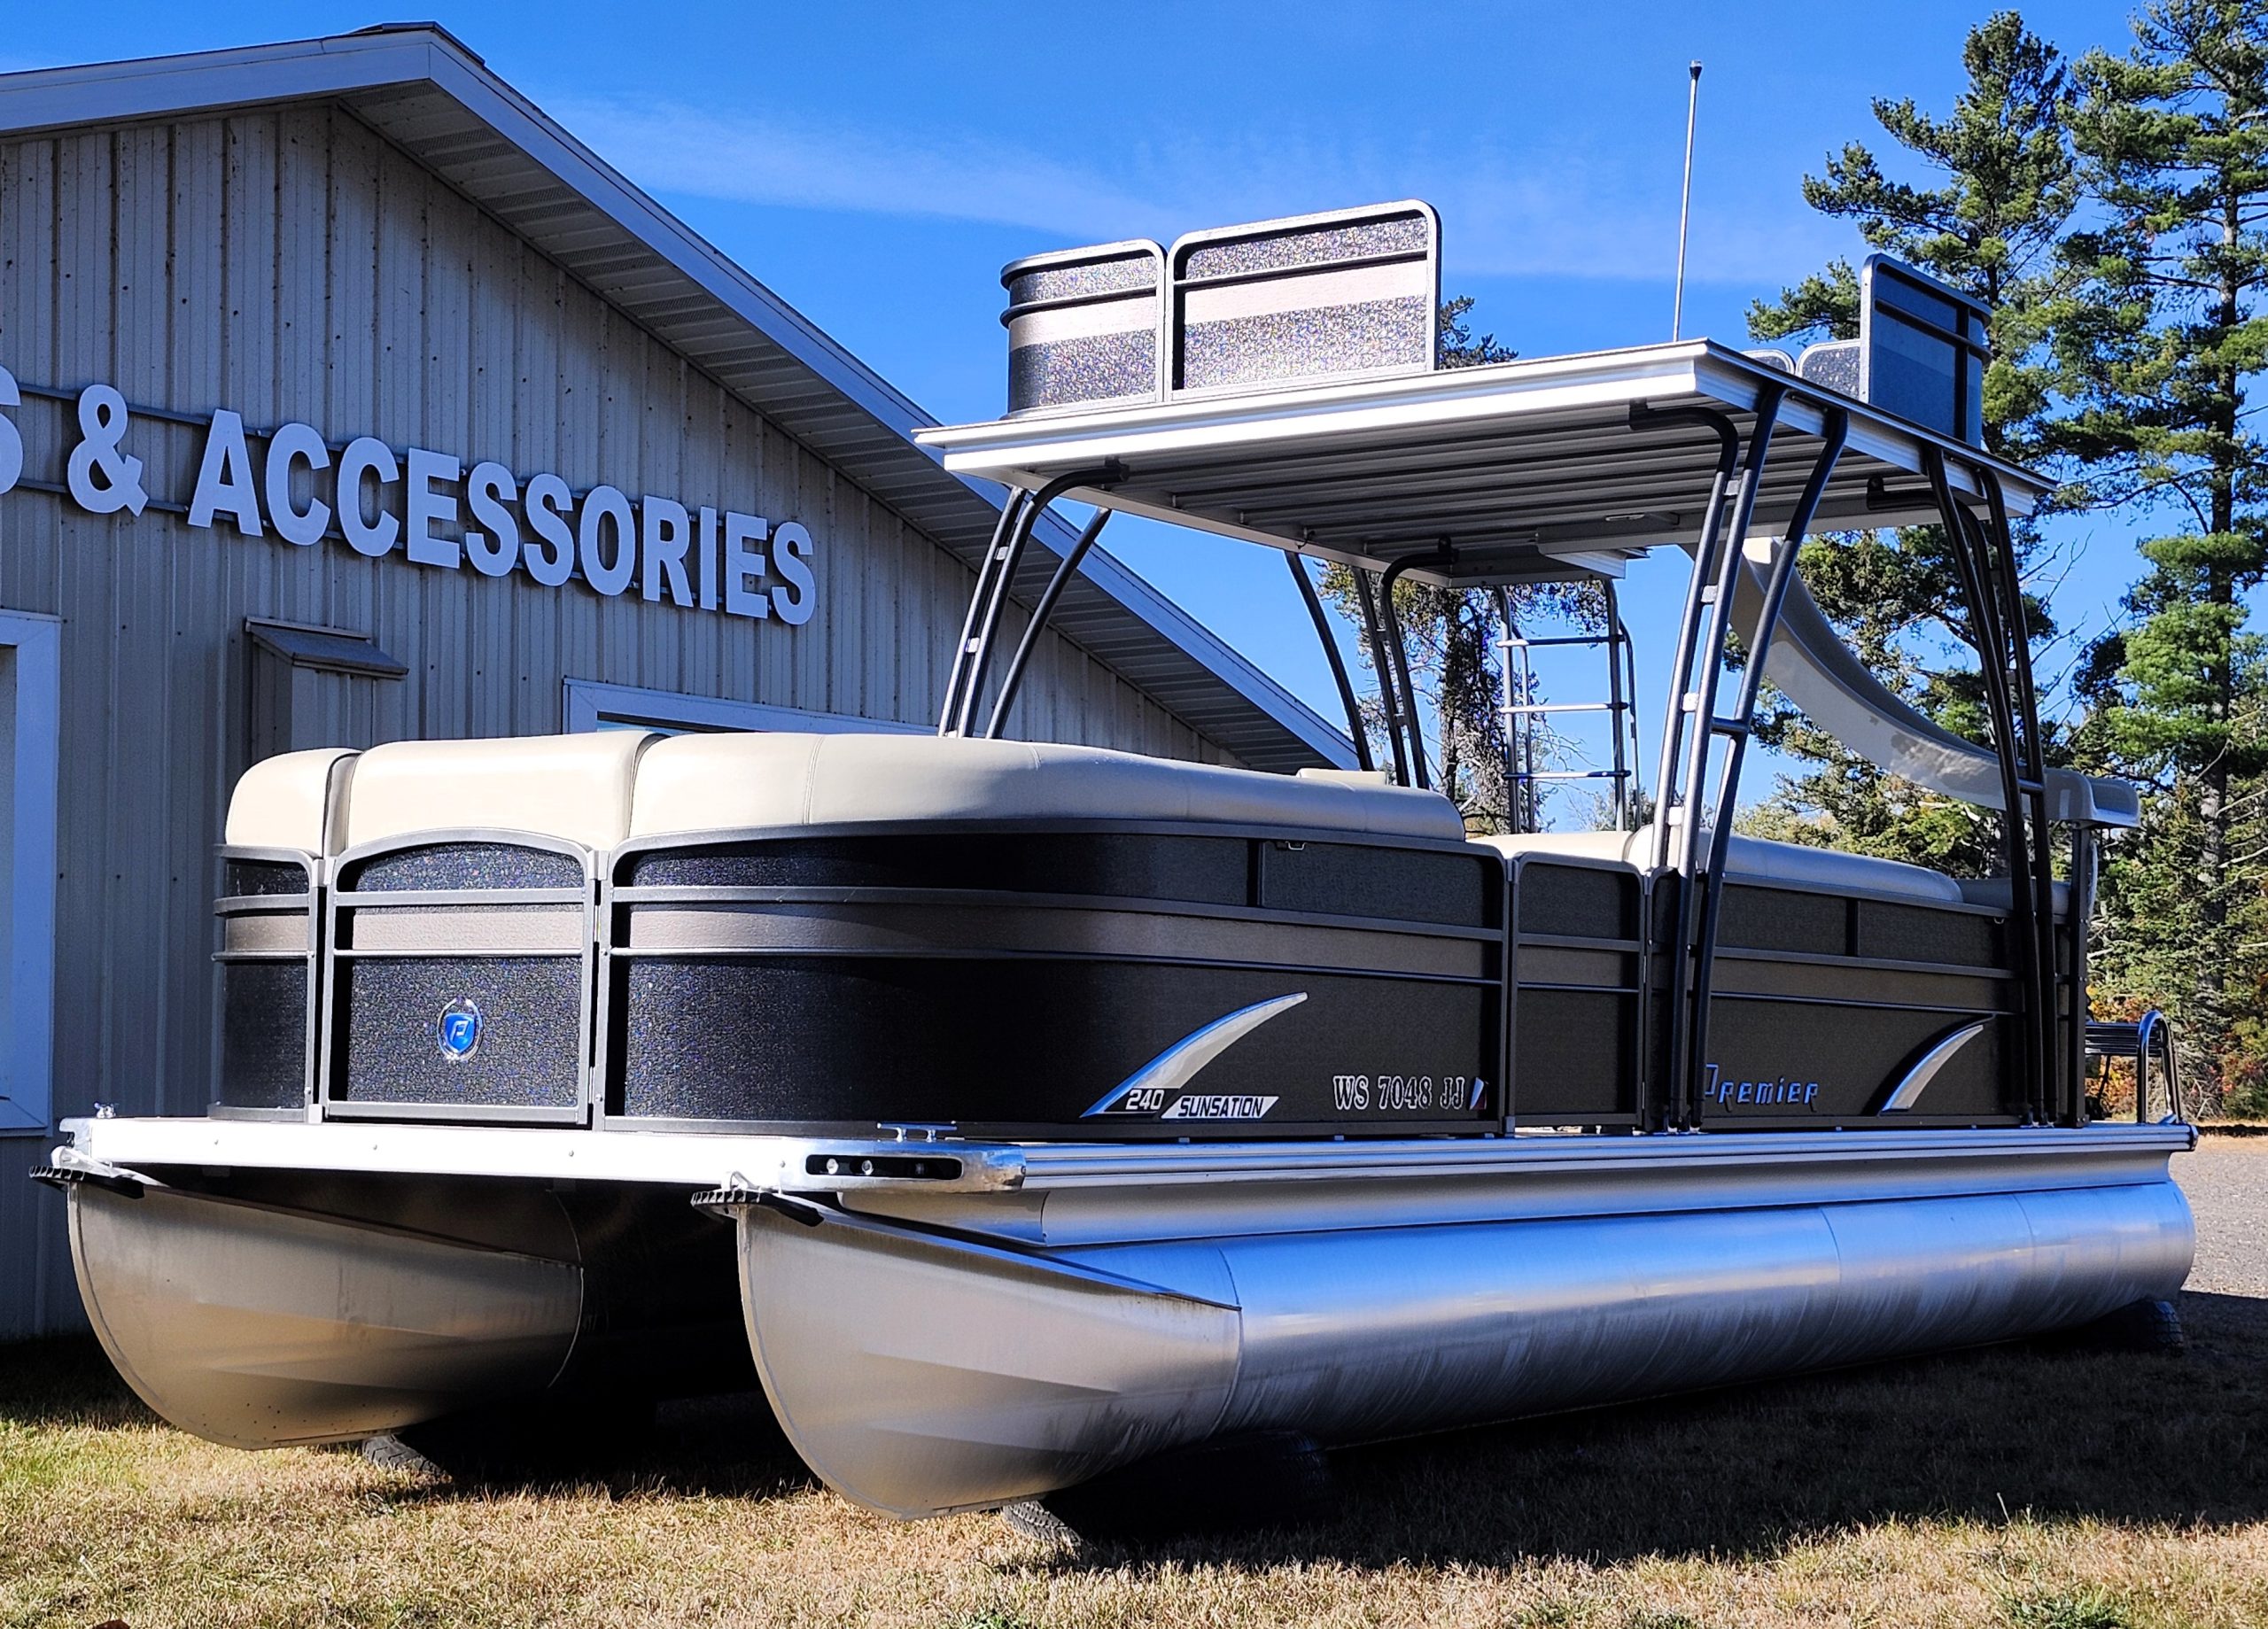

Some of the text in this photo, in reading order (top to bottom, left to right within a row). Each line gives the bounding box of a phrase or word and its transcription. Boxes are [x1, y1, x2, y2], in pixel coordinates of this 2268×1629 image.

[67, 384, 150, 517] &
[188, 408, 817, 625] ACCESSORIES
[1125, 1089, 1264, 1117] 240 SUNSATION
[1332, 1074, 1465, 1110] WS 7048 JJ
